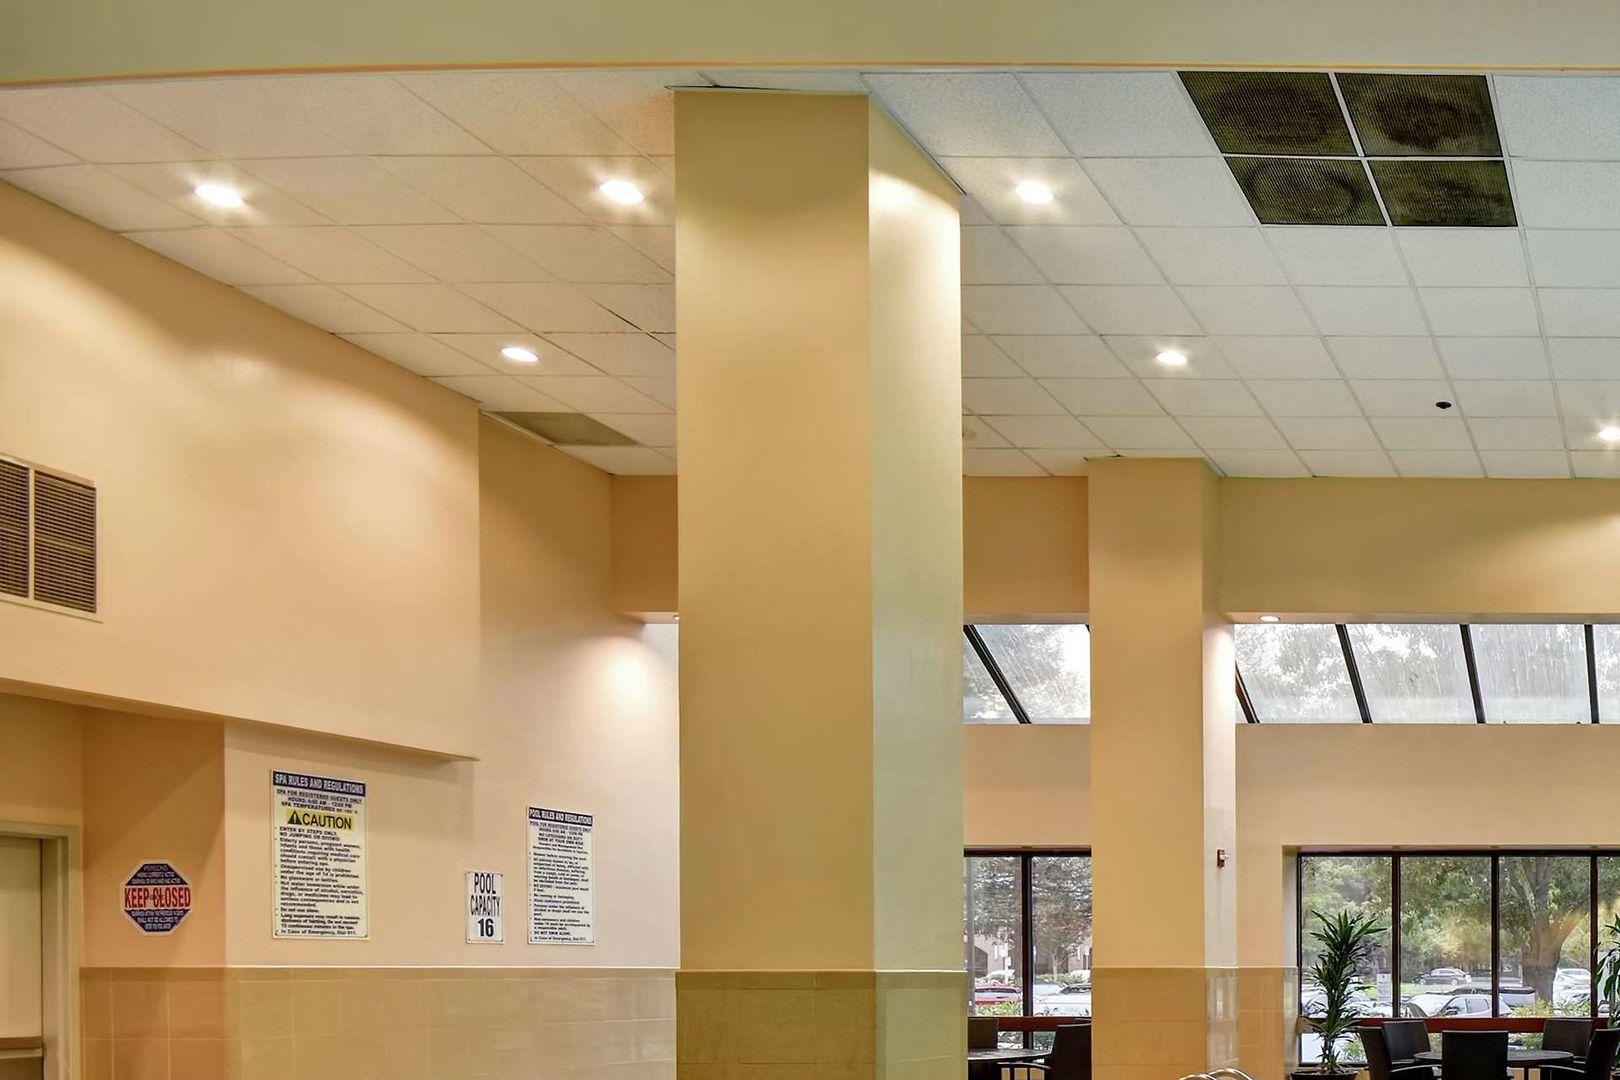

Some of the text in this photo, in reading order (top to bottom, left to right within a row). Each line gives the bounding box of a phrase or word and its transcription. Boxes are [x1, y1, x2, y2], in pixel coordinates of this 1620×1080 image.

[275, 774, 363, 794] SPA RULES AND REGULATIONS
[303, 813, 351, 829] CAUTION
[529, 809, 592, 824] POOL RULES AND REGULATIONS
[474, 873, 496, 894] POOL
[124, 887, 149, 908] KEEP
[470, 895, 500, 916] CAPACITY
[478, 918, 494, 937] 16
